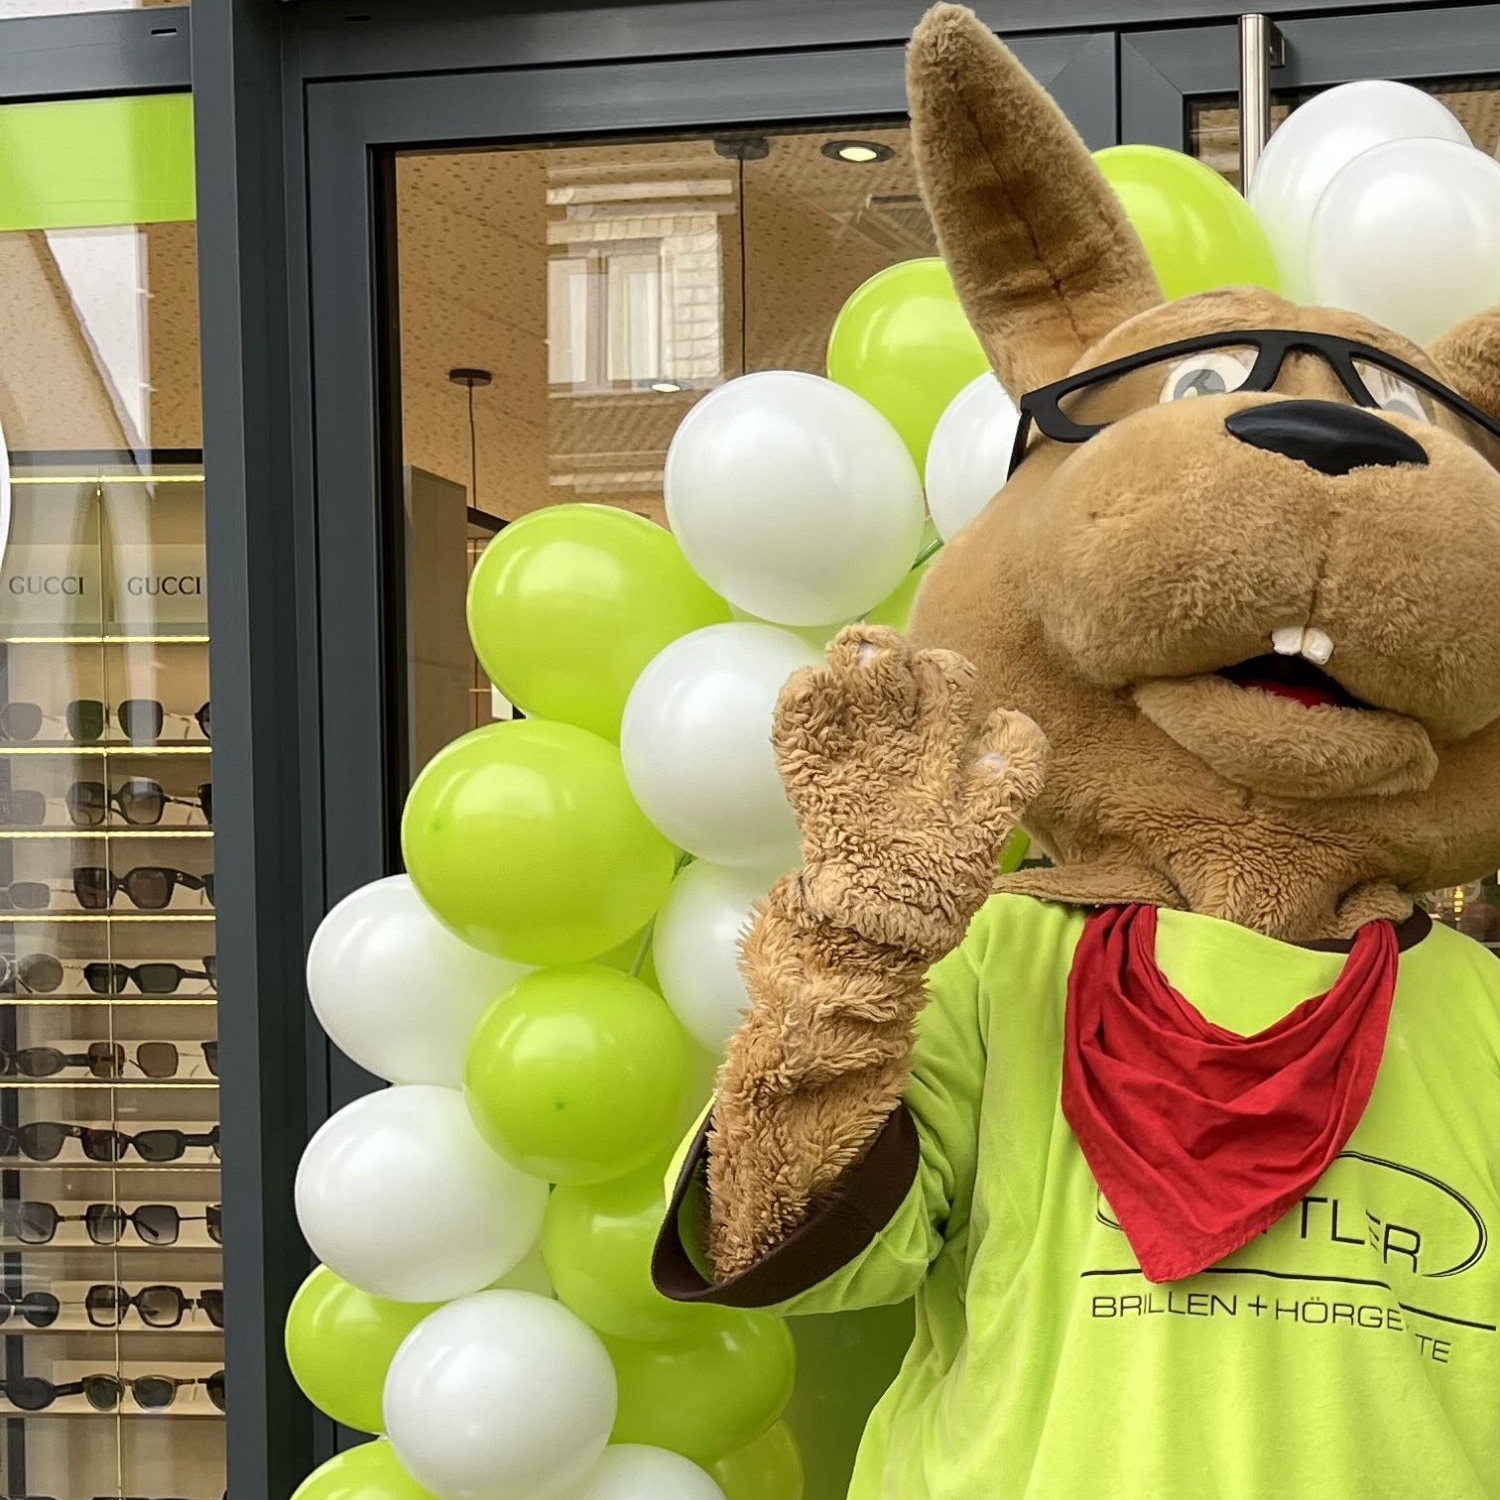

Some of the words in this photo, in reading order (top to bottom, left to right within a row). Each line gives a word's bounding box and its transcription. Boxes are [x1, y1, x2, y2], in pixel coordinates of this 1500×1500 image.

[9, 575, 84, 595] GUCCI
[127, 576, 202, 596] GUCCI
[1300, 1195, 1422, 1274] TLER
[1091, 1292, 1238, 1319] BRILLEN
